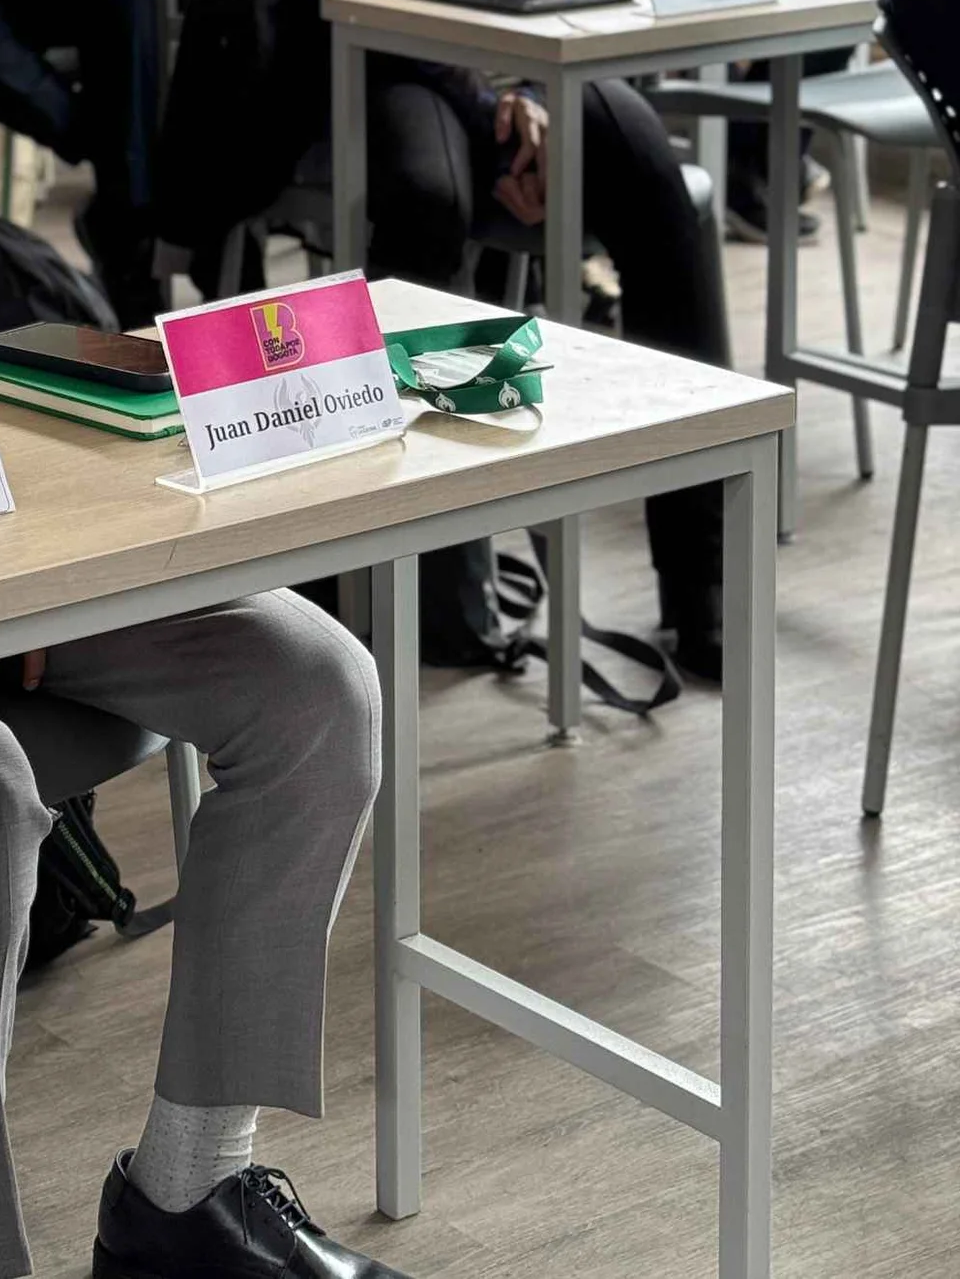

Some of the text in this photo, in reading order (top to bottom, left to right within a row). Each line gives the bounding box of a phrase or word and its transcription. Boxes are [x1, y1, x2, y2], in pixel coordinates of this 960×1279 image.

[205, 384, 384, 451] Juan Daniel Oviedo
